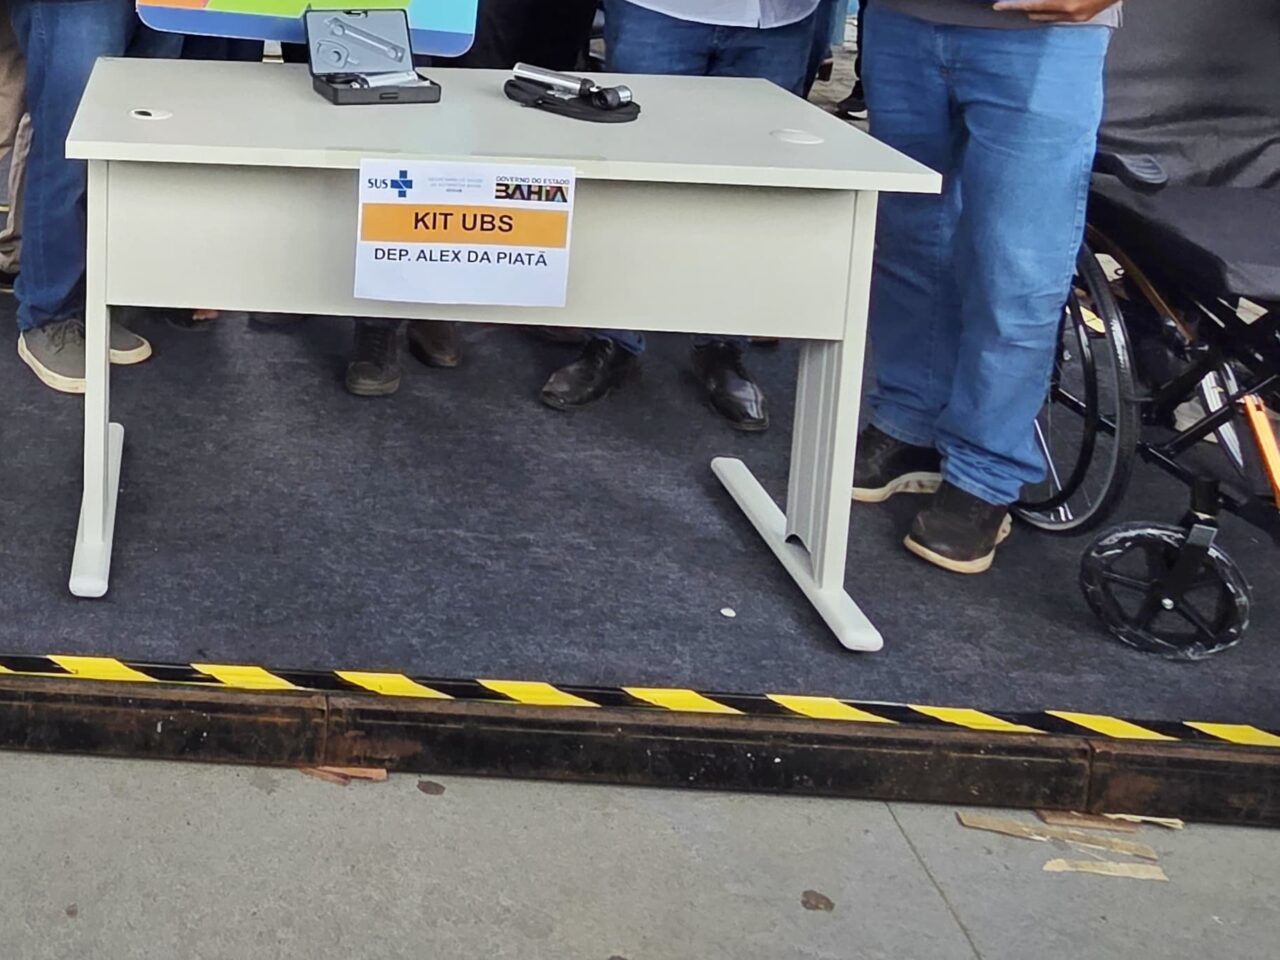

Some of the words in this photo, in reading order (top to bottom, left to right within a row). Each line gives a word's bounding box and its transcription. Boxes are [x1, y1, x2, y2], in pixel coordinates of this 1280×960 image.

[368, 178, 388, 189] SUS
[532, 176, 542, 184] DO
[543, 177, 570, 185] ESTADO
[495, 183, 568, 202] BAHIA
[414, 212, 453, 230] KIT
[462, 213, 514, 232] UBS
[374, 248, 411, 261] DEP.
[416, 249, 461, 263] ALEX
[467, 250, 491, 264] DA
[496, 250, 548, 267] PIATÃ
